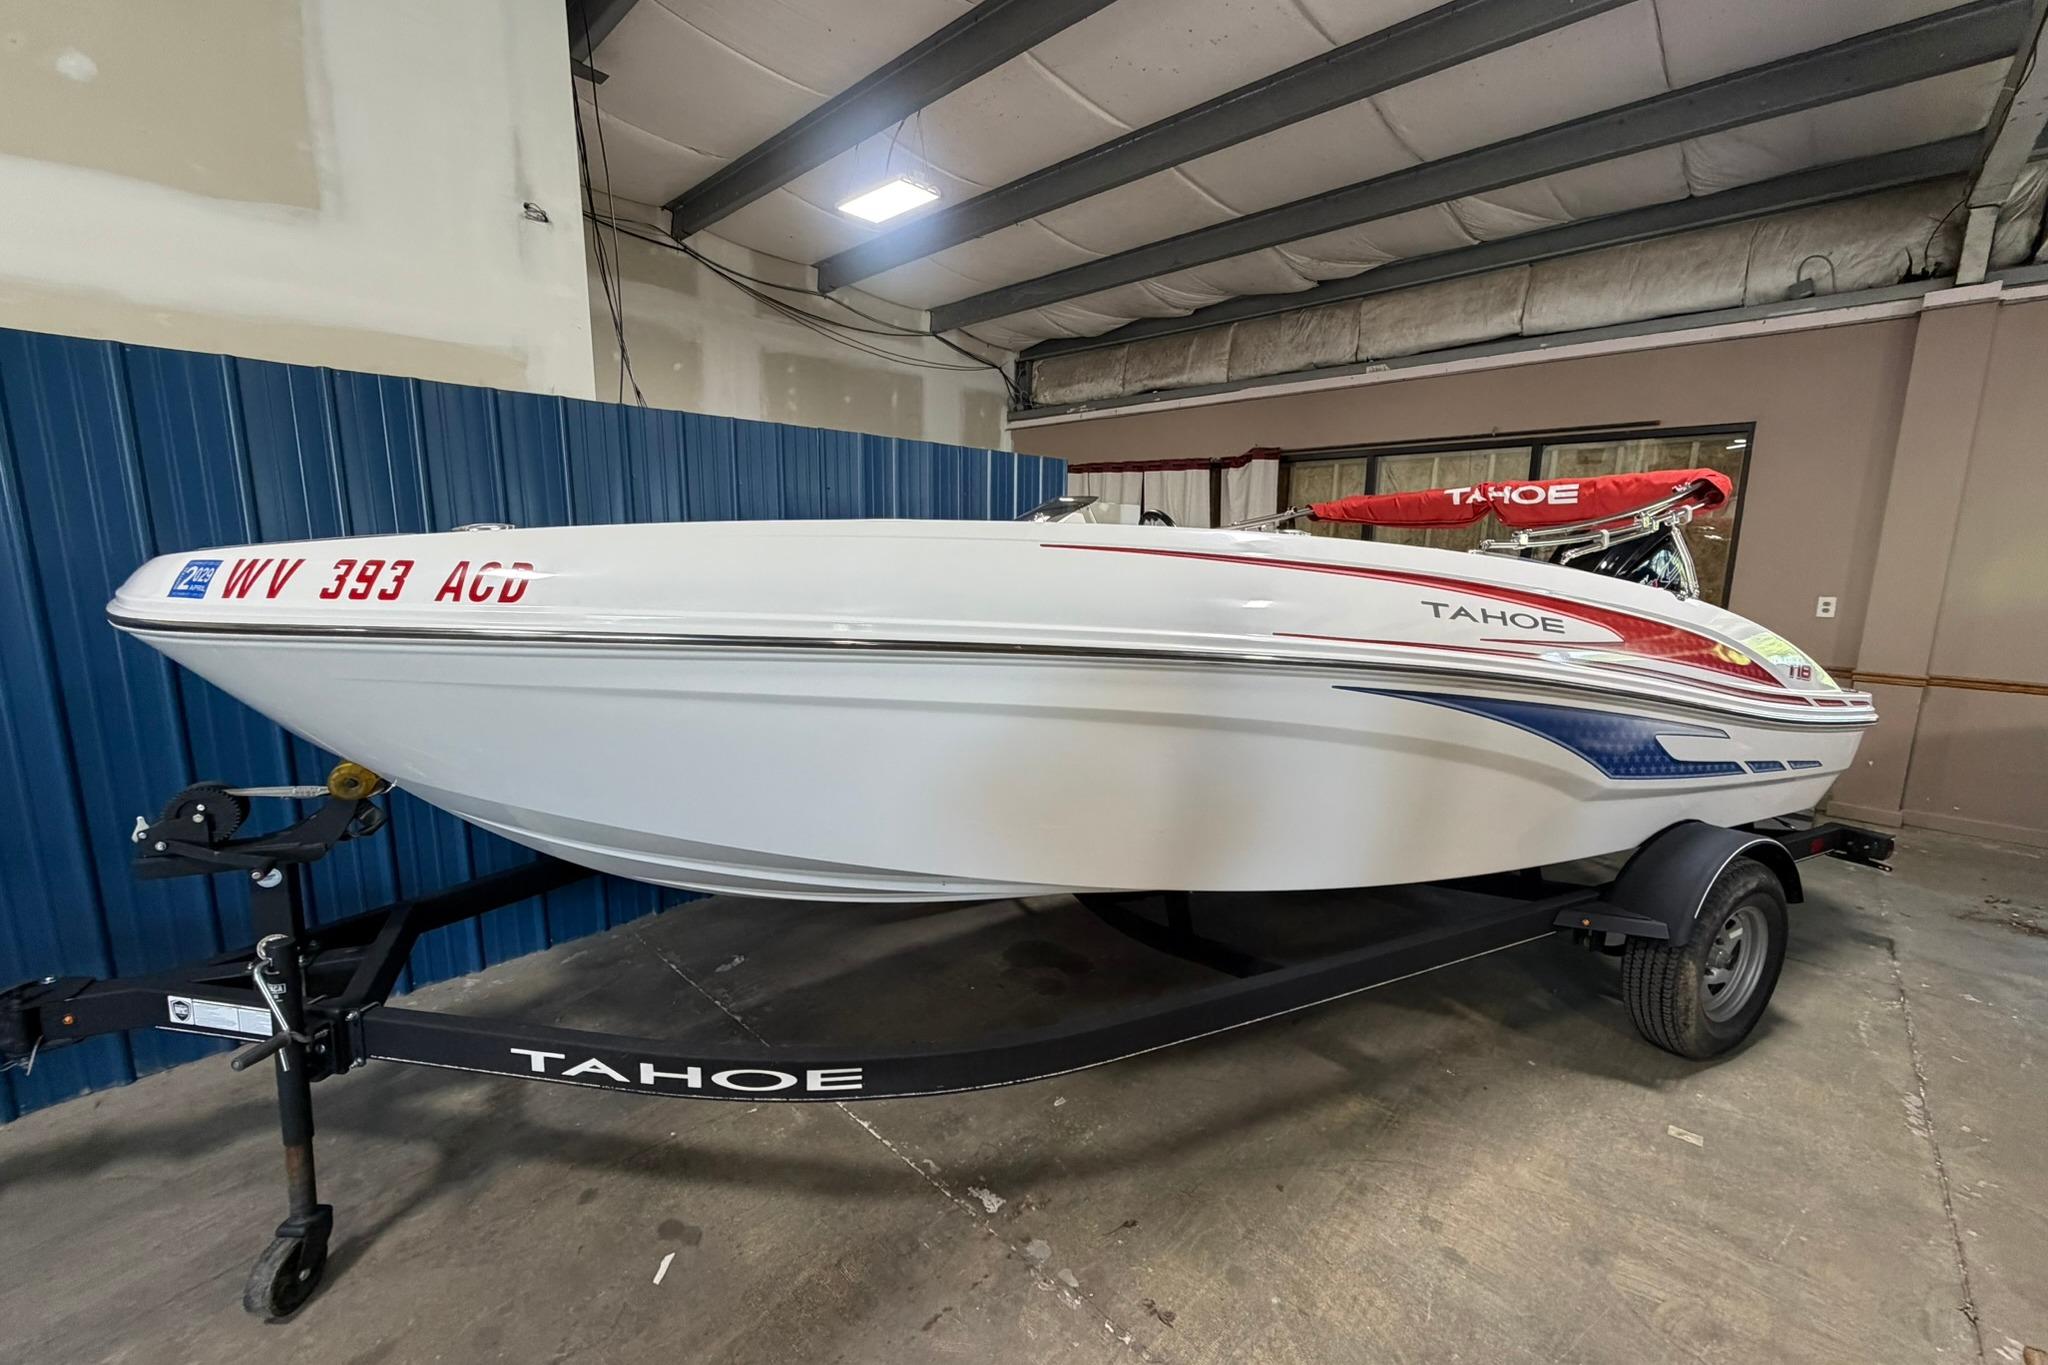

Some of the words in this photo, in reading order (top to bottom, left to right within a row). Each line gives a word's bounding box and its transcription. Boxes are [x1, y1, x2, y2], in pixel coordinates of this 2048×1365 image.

[1444, 483, 1580, 505] TAHOE
[176, 566, 215, 590] 2029
[221, 559, 307, 599] WV
[319, 560, 415, 600] 393
[434, 560, 534, 603] ACD
[1421, 600, 1566, 634] TAHOE
[510, 1048, 863, 1092] TAHOE
